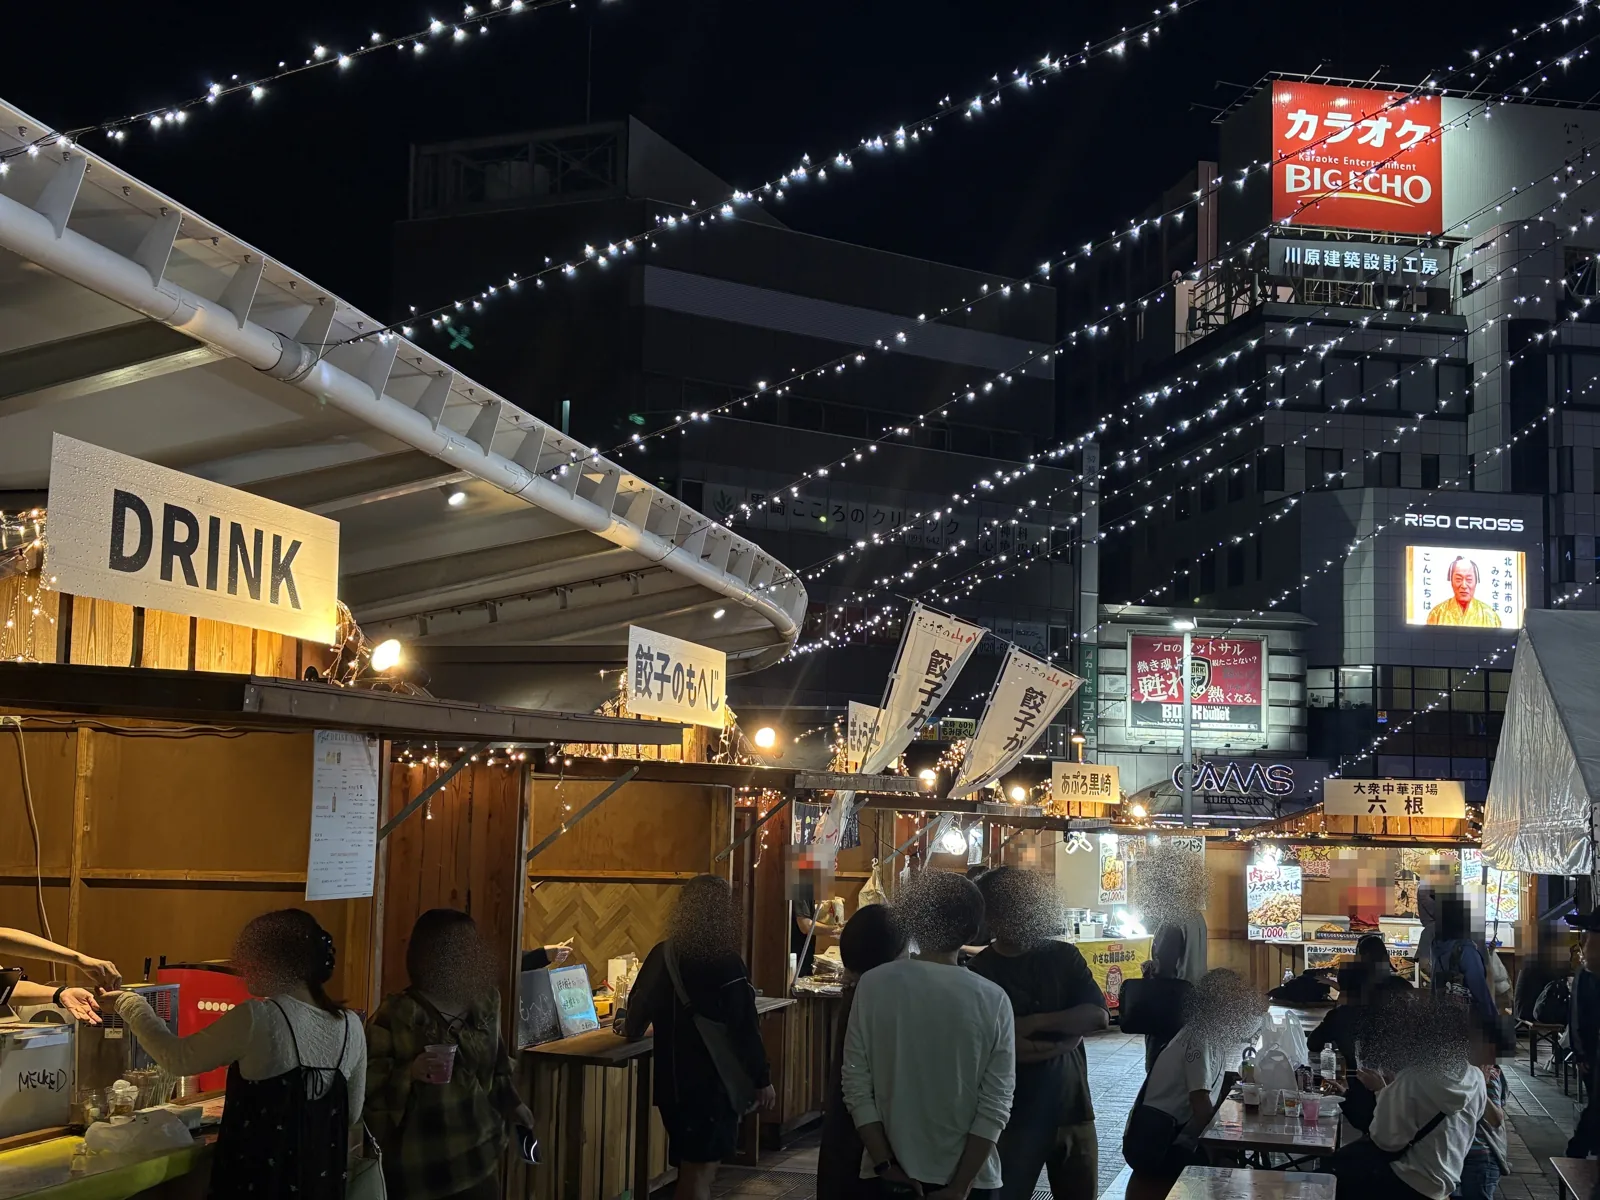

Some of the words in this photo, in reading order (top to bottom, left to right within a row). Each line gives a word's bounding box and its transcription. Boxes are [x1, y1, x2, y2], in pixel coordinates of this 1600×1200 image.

[1285, 109, 1432, 150] カラオケ
[1298, 152, 1339, 165] Karaoke
[1343, 156, 1417, 171] Entertainment
[1285, 164, 1341, 193] BIG
[1349, 171, 1432, 204] ECHO
[1285, 246, 1440, 276] 川原建築設計工房
[1456, 516, 1525, 532] CROSS
[109, 488, 303, 610] DRINK
[1422, 552, 1432, 611] こんにちは
[1491, 566, 1499, 612] みなさま
[1504, 556, 1513, 614] 北九州市の
[634, 643, 720, 712] 餃子のもへじ
[1162, 704, 1202, 721] BOK
[942, 728, 975, 737] もみほぐし
[1061, 770, 1112, 797] あぷろ黒崎
[1353, 782, 1439, 796] 大衆中華酒場
[1203, 795, 1265, 806] KUROSAKI
[1248, 879, 1301, 893] ソース焼きそば
